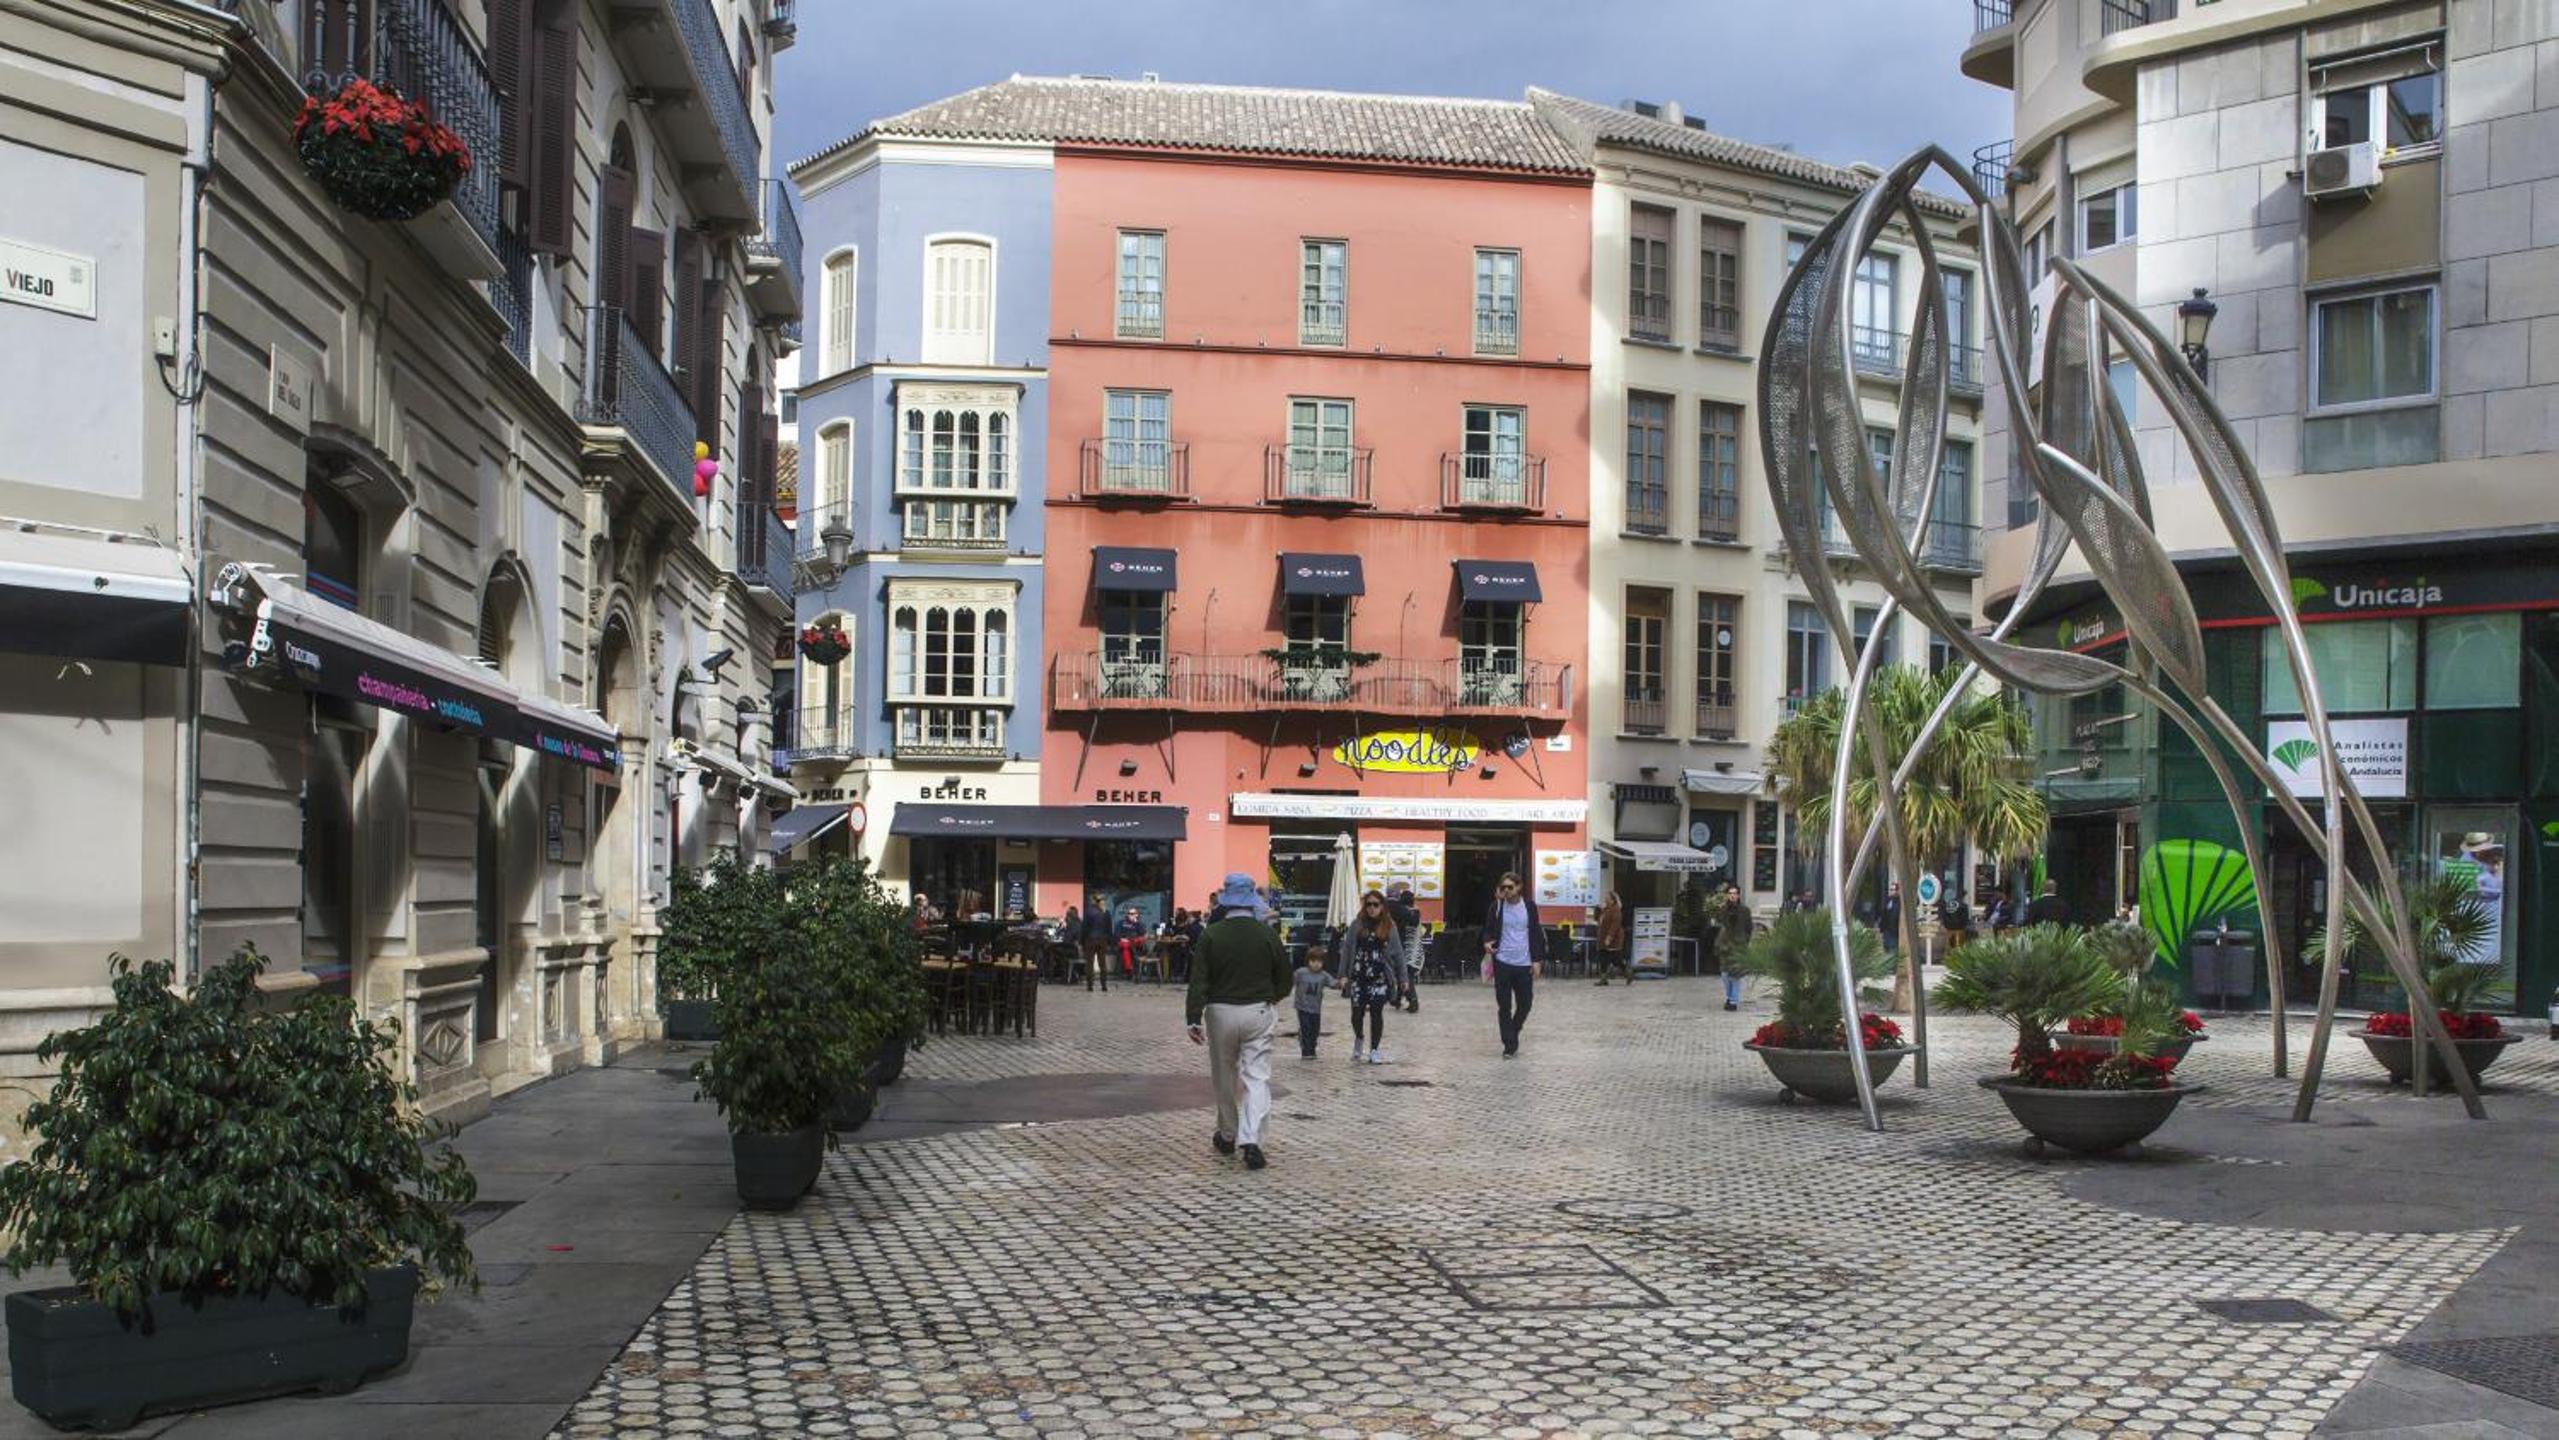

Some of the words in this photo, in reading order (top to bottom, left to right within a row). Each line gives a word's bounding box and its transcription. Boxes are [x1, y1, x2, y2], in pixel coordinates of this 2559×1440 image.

[6, 268, 54, 297] VIEJO
[2334, 576, 2444, 608] Unicaja
[2073, 614, 2105, 644] Unicaja
[1342, 723, 1468, 771] noodles
[2335, 741, 2403, 750] Analistas
[2338, 755, 2403, 764] conómicos
[811, 788, 844, 801] BEHER
[920, 786, 987, 800] BEHER
[1096, 789, 1162, 803] BEHER
[1458, 807, 1488, 818] FOOD
